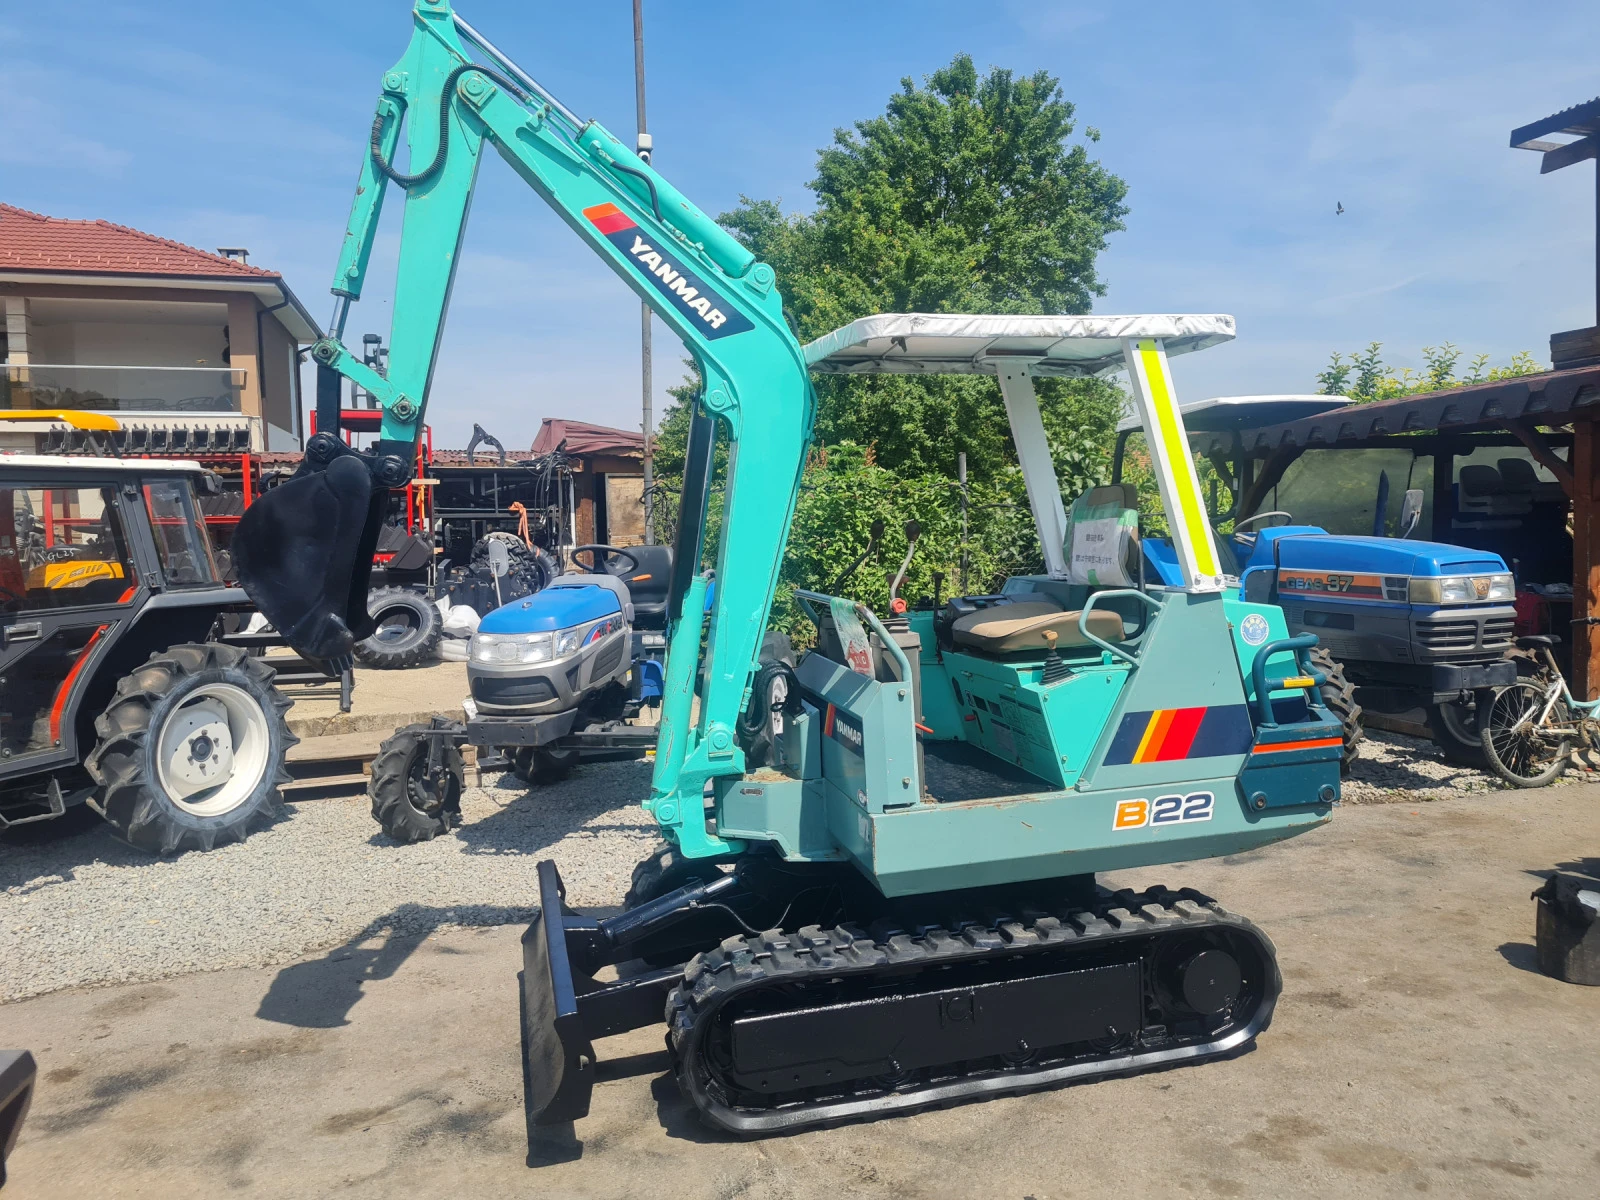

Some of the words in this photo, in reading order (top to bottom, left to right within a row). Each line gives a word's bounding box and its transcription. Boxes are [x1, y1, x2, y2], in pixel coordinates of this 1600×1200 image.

[630, 235, 727, 329] YANMAR
[1327, 574, 1354, 592] 37
[836, 718, 862, 746] YANMAR
[1114, 793, 1213, 829] B22
